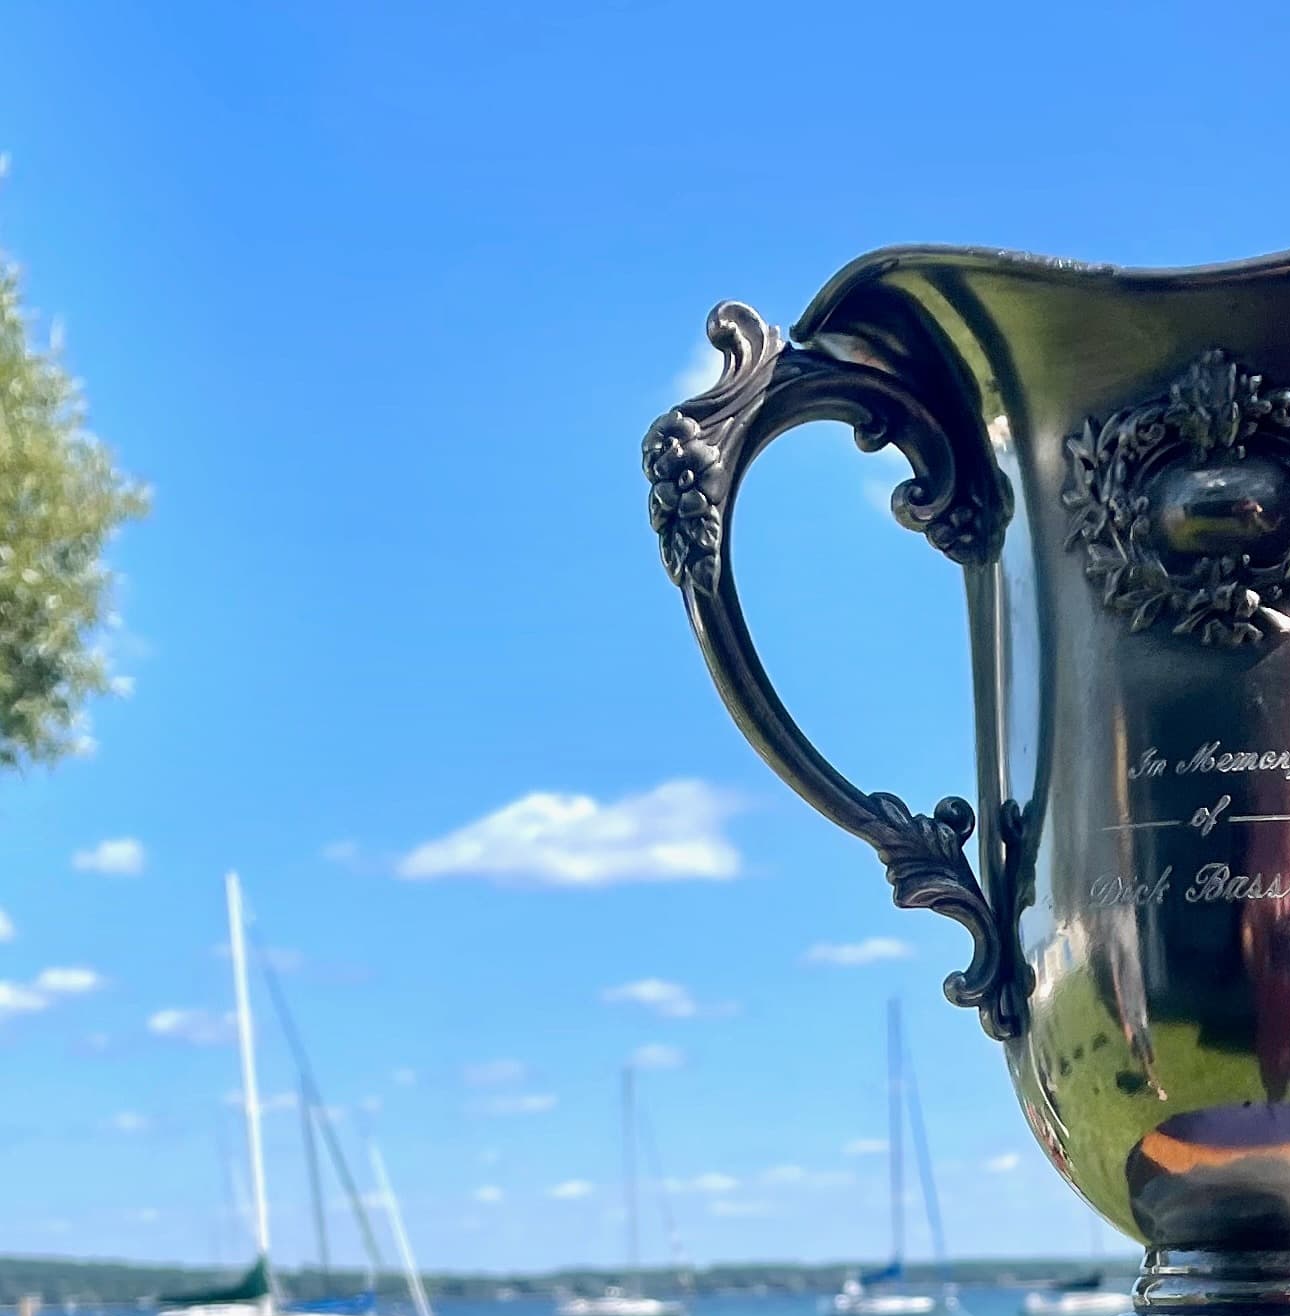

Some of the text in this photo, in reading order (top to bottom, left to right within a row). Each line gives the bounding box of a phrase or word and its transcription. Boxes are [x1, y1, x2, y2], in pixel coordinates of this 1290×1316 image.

[1129, 746, 1167, 779] In
[1188, 795, 1231, 837] of
[1091, 865, 1172, 904] Dick
